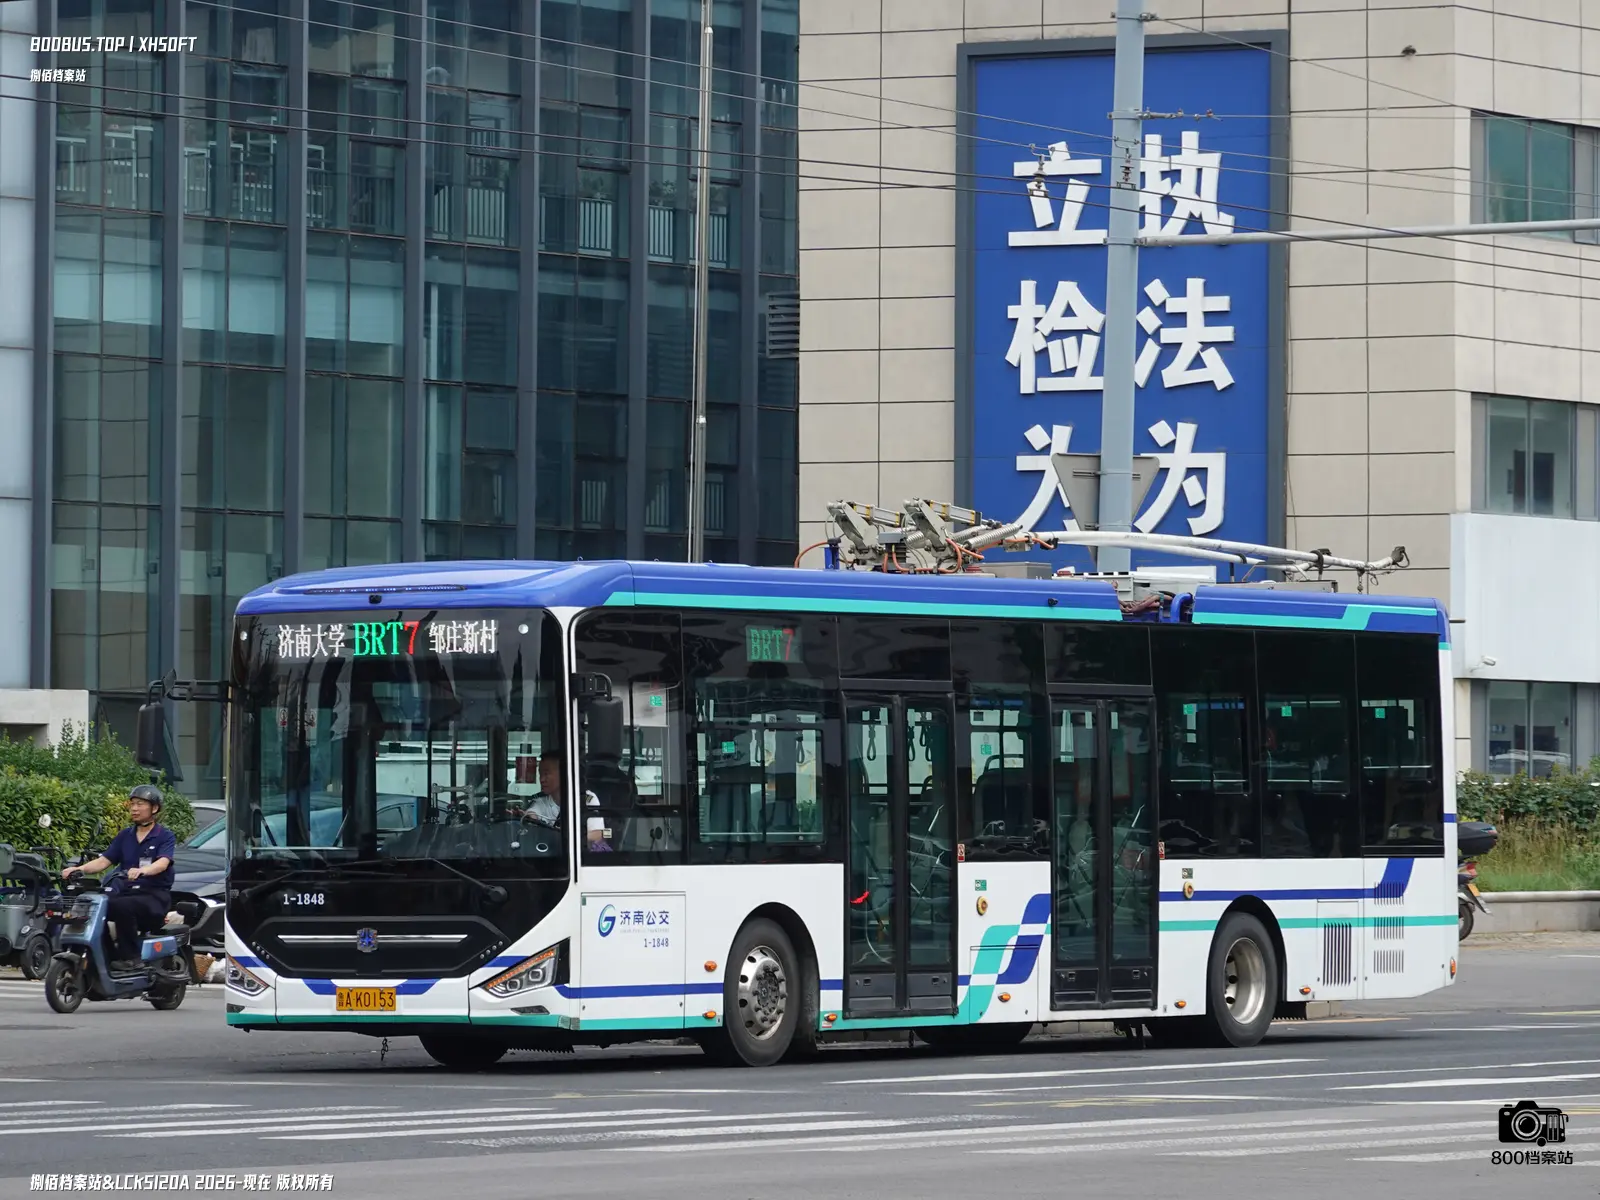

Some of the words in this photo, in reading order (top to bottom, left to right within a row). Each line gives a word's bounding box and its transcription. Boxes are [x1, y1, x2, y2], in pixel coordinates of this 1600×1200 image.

[277, 624, 346, 658] 济南大学
[428, 619, 497, 655] 邹庄新村
[283, 893, 325, 905] 1-1848
[620, 910, 670, 926] 济南公交
[643, 937, 670, 948] 1-1848
